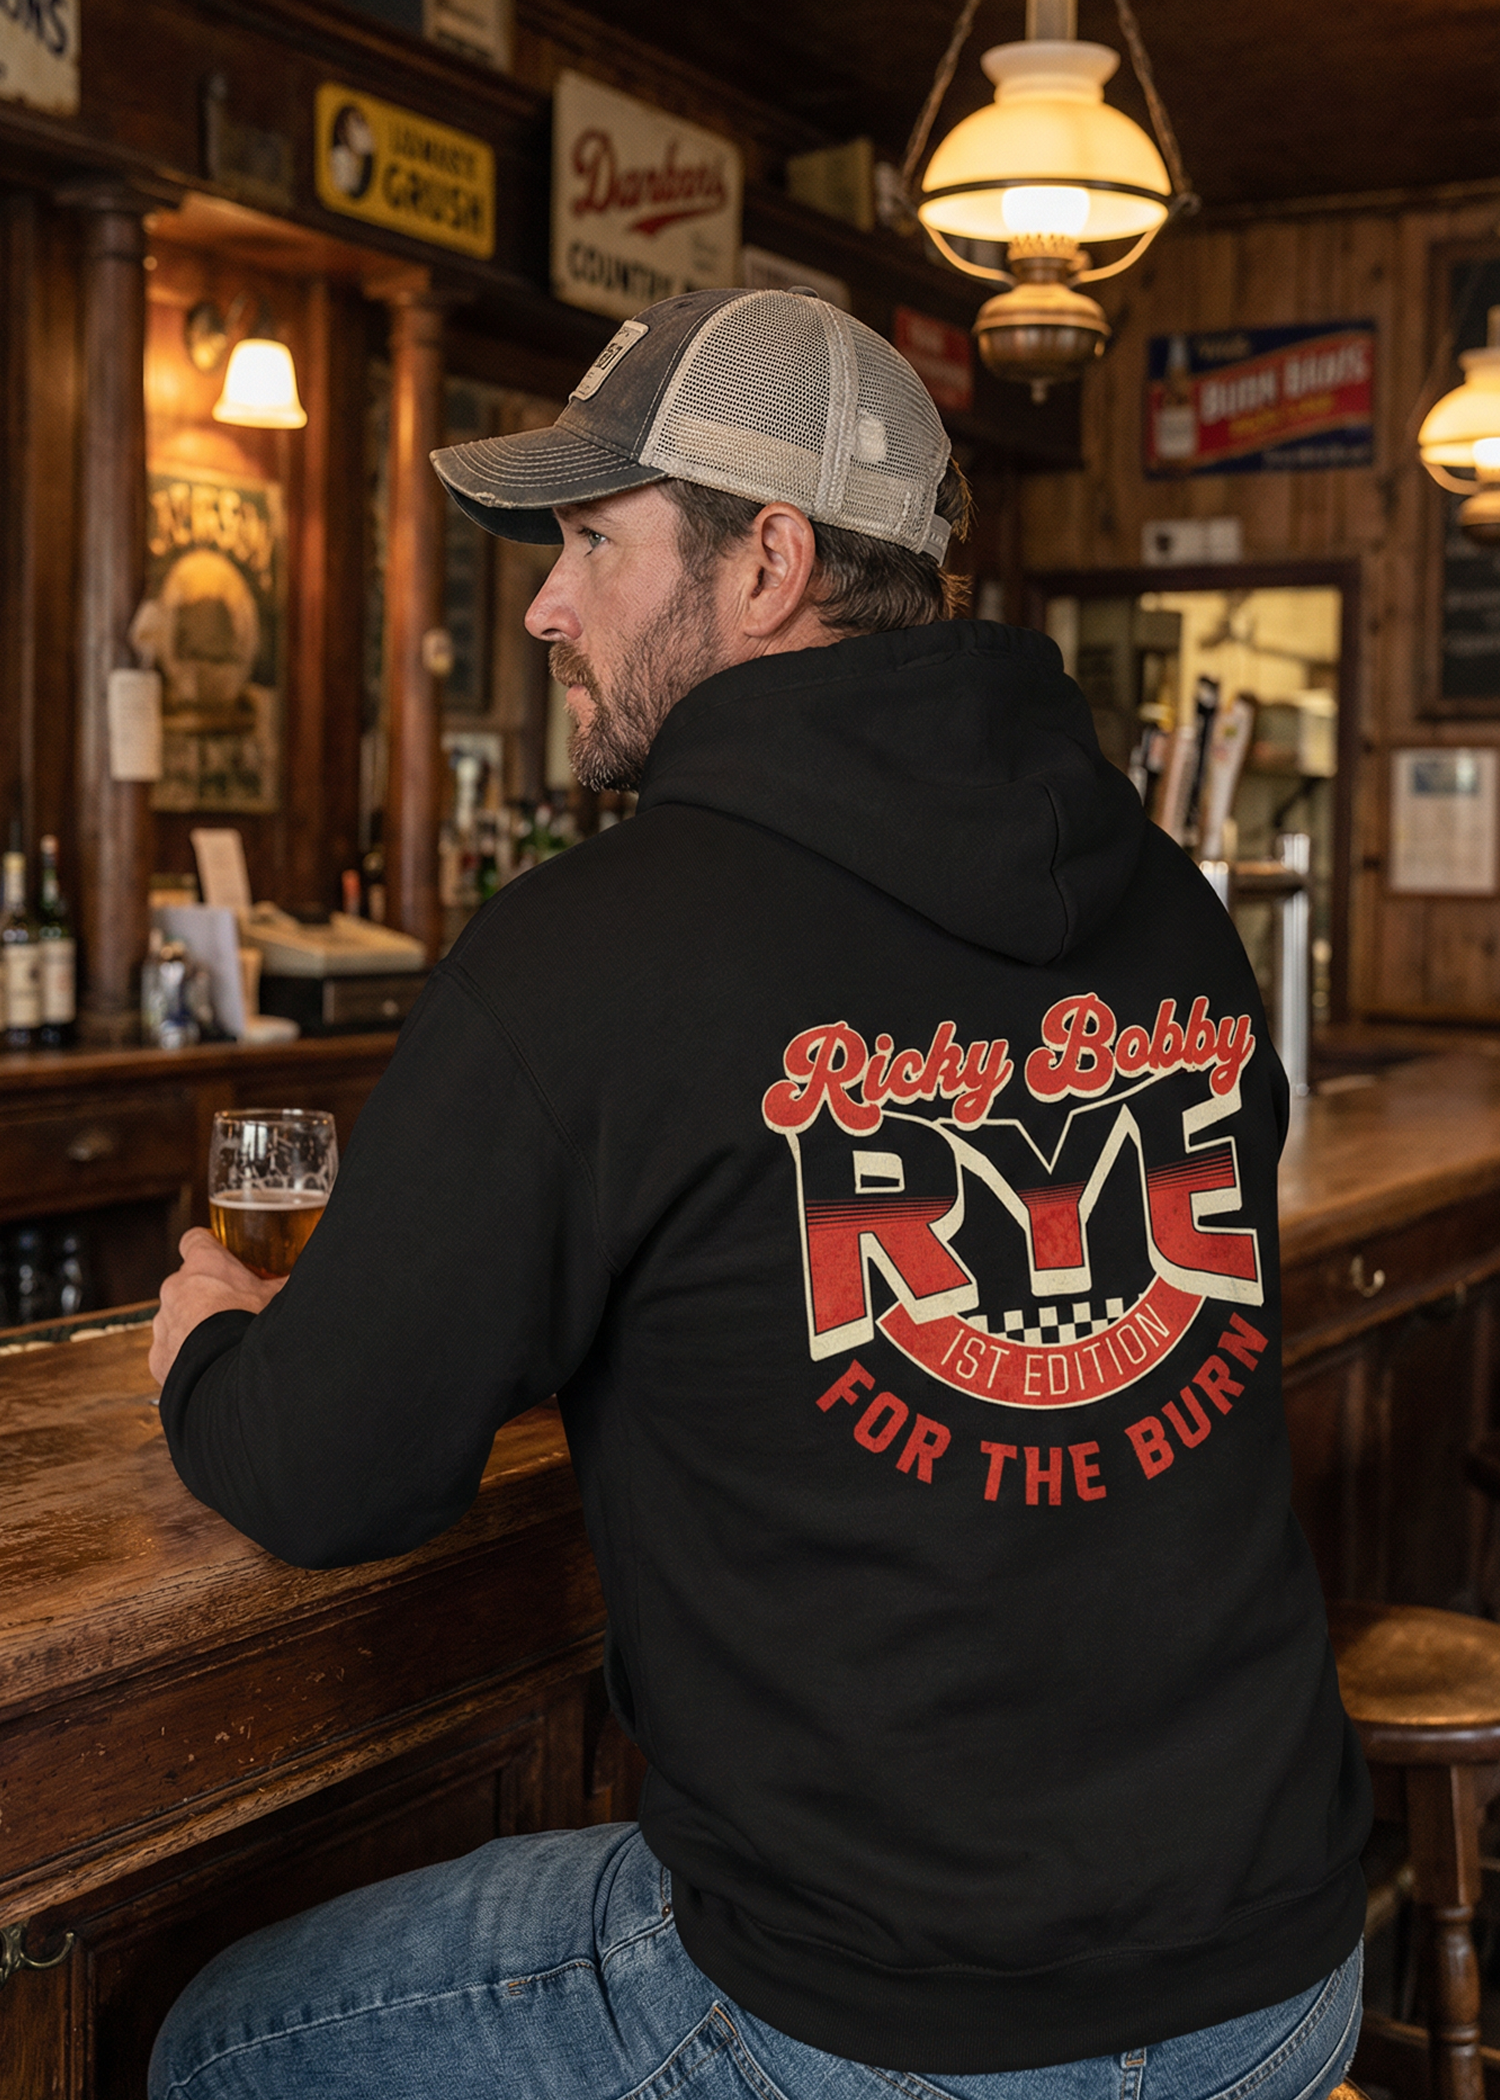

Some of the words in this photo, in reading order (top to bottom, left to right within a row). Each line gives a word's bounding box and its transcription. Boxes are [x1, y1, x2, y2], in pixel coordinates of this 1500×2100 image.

[762, 1020, 1014, 1137] Ricky
[1024, 992, 1256, 1102] Bobby
[786, 1072, 1264, 1362] RYE
[815, 1359, 952, 1485] FOR
[980, 1440, 1108, 1506] THE
[1124, 1312, 1270, 1481] BURN
[940, 1328, 1010, 1390] 1ST
[1022, 1302, 1171, 1396] EDITION
